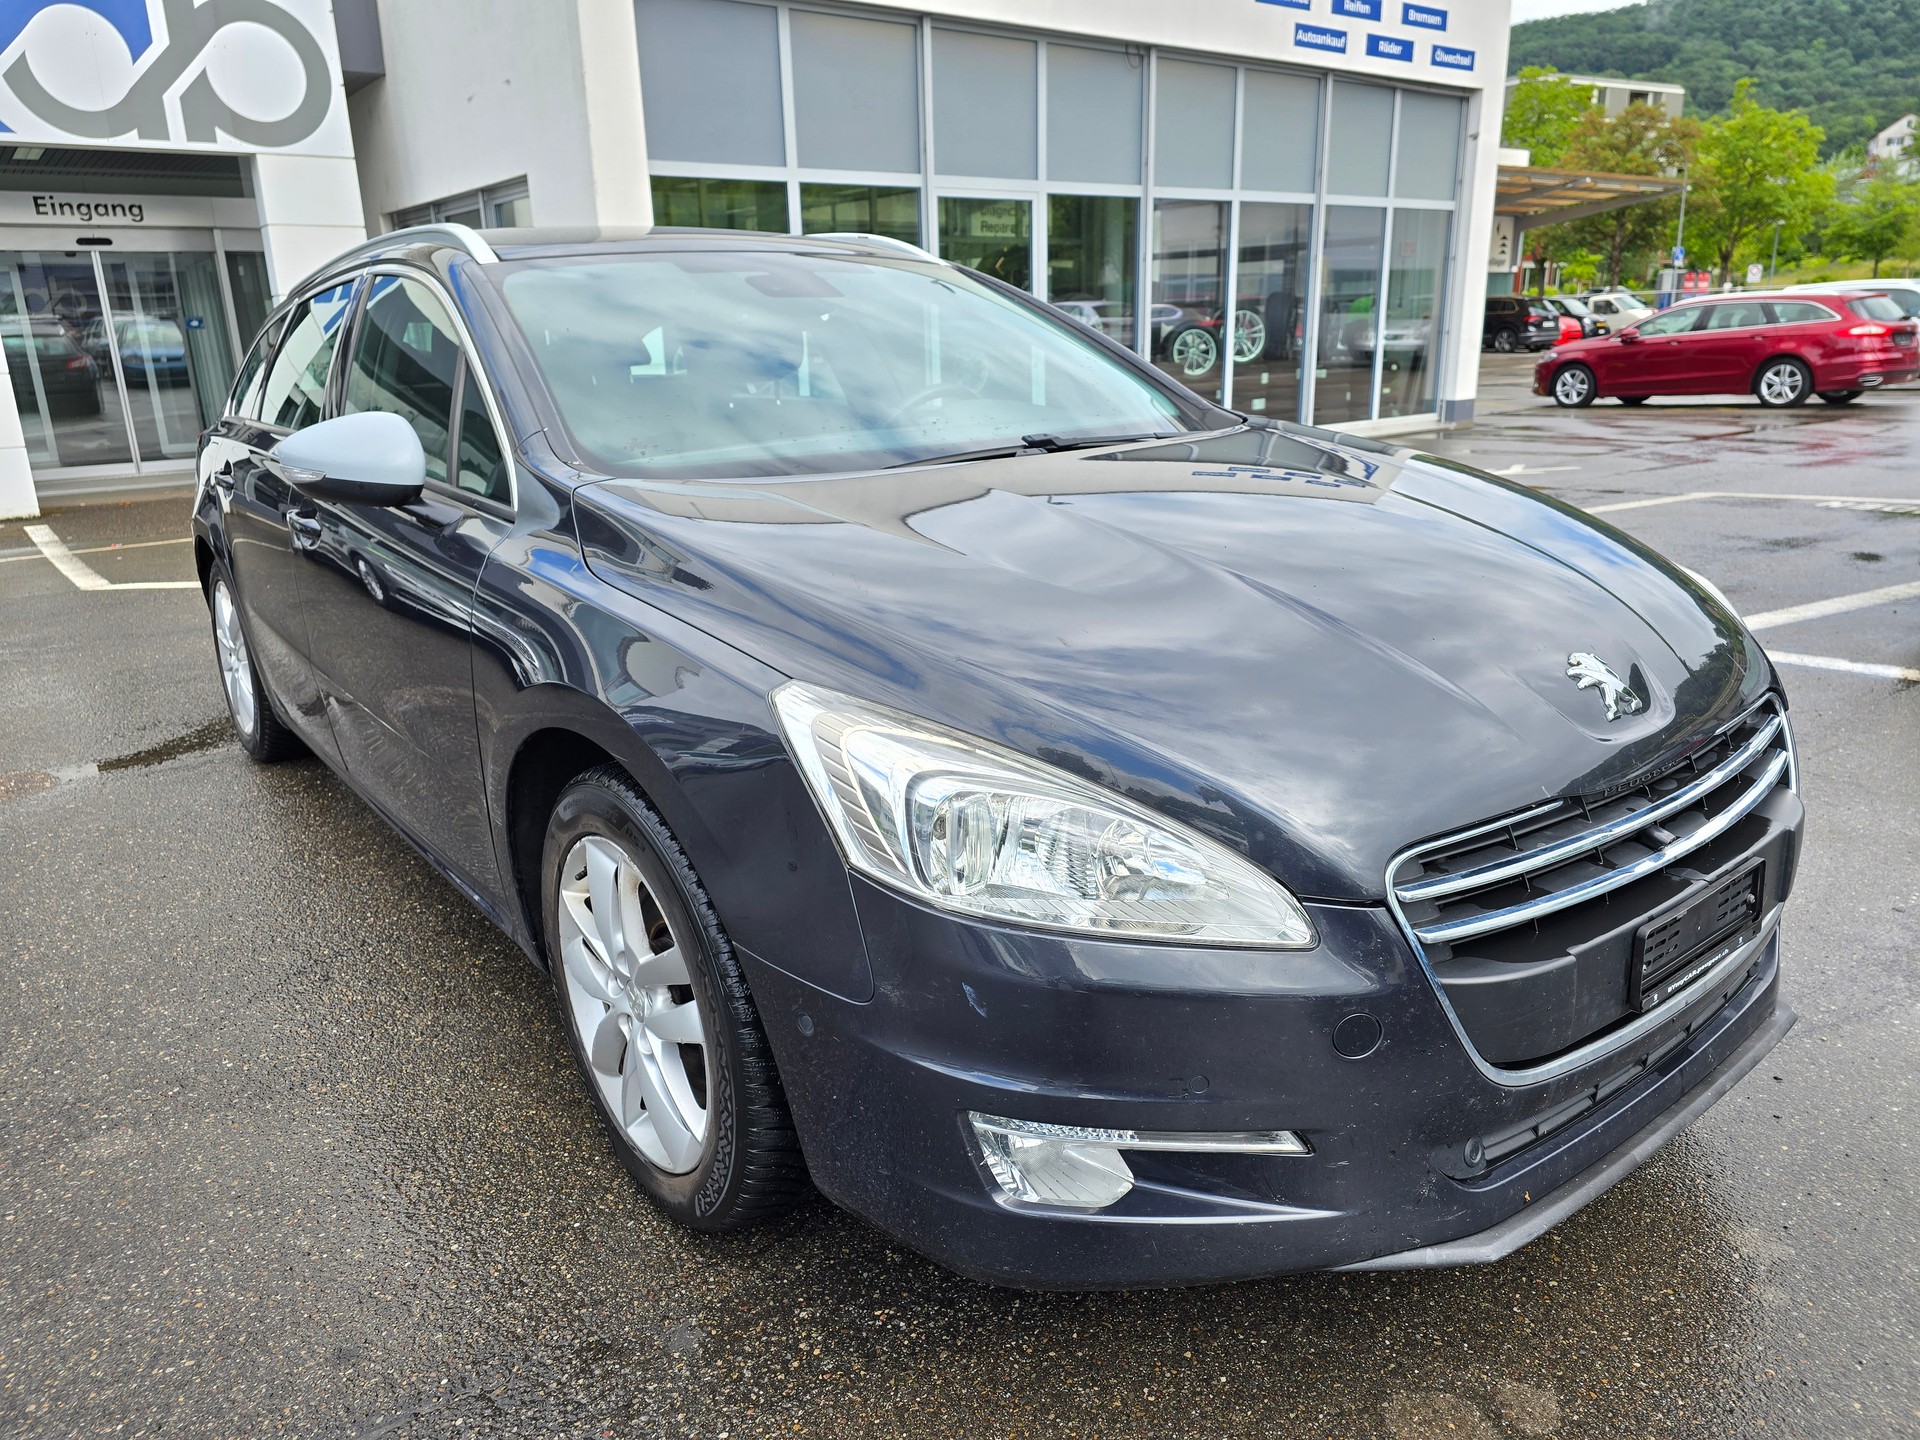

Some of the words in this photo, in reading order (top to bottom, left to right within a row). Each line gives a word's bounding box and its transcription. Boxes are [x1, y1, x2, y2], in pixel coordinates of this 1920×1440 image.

[1343, 0, 1371, 14] Reifen
[1408, 9, 1442, 26] Bremsen
[1296, 28, 1346, 48] Autoankauf
[1378, 40, 1403, 55] Räder
[1434, 48, 1472, 66] Ölwechsel
[33, 195, 145, 223] Eingang
